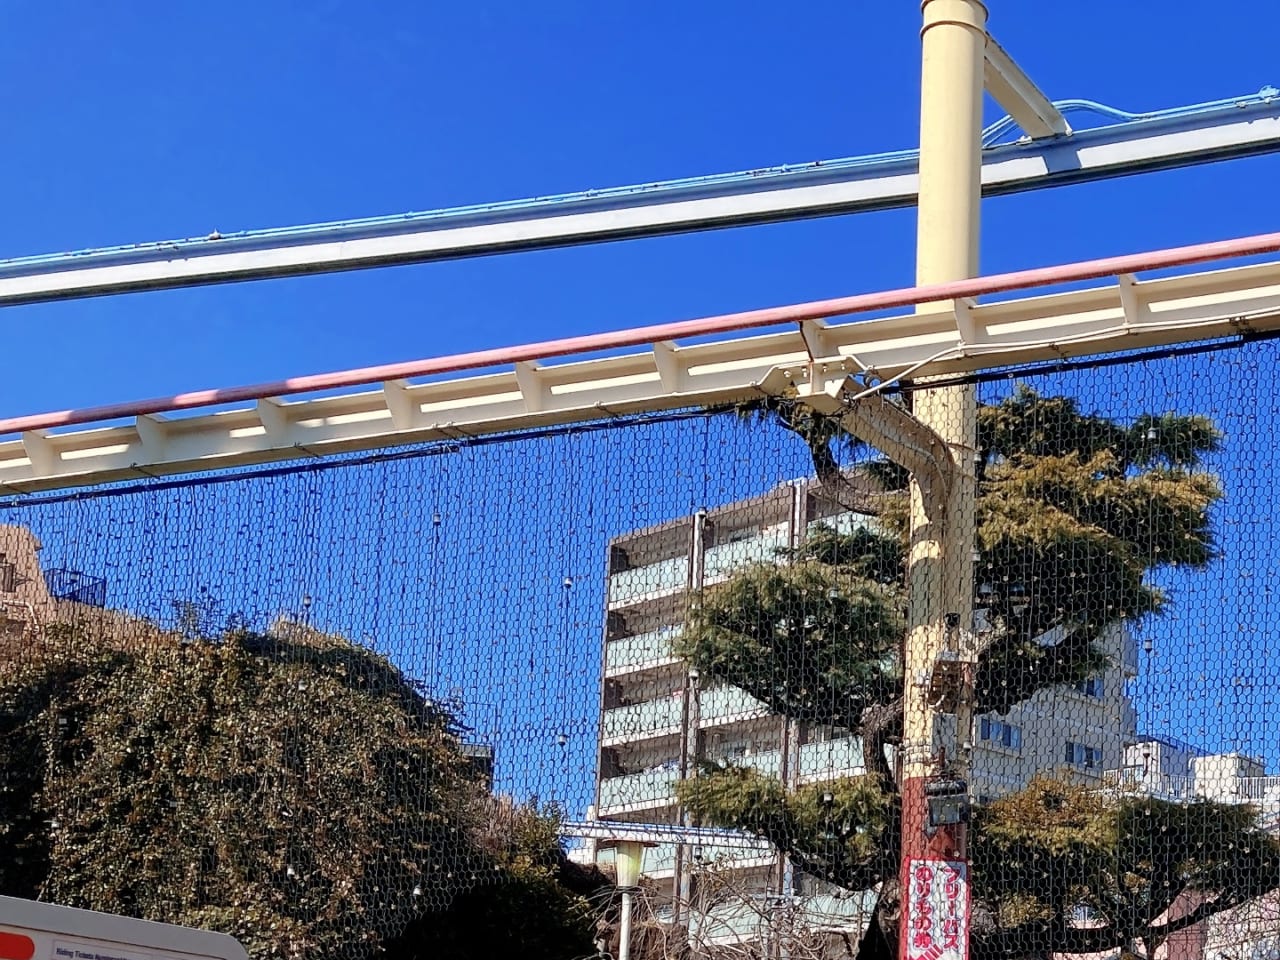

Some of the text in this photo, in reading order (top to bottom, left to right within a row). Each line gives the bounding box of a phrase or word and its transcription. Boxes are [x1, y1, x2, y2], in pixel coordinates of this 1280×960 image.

[914, 866, 934, 950] のりもの券
[943, 866, 961, 950] フリーパス
